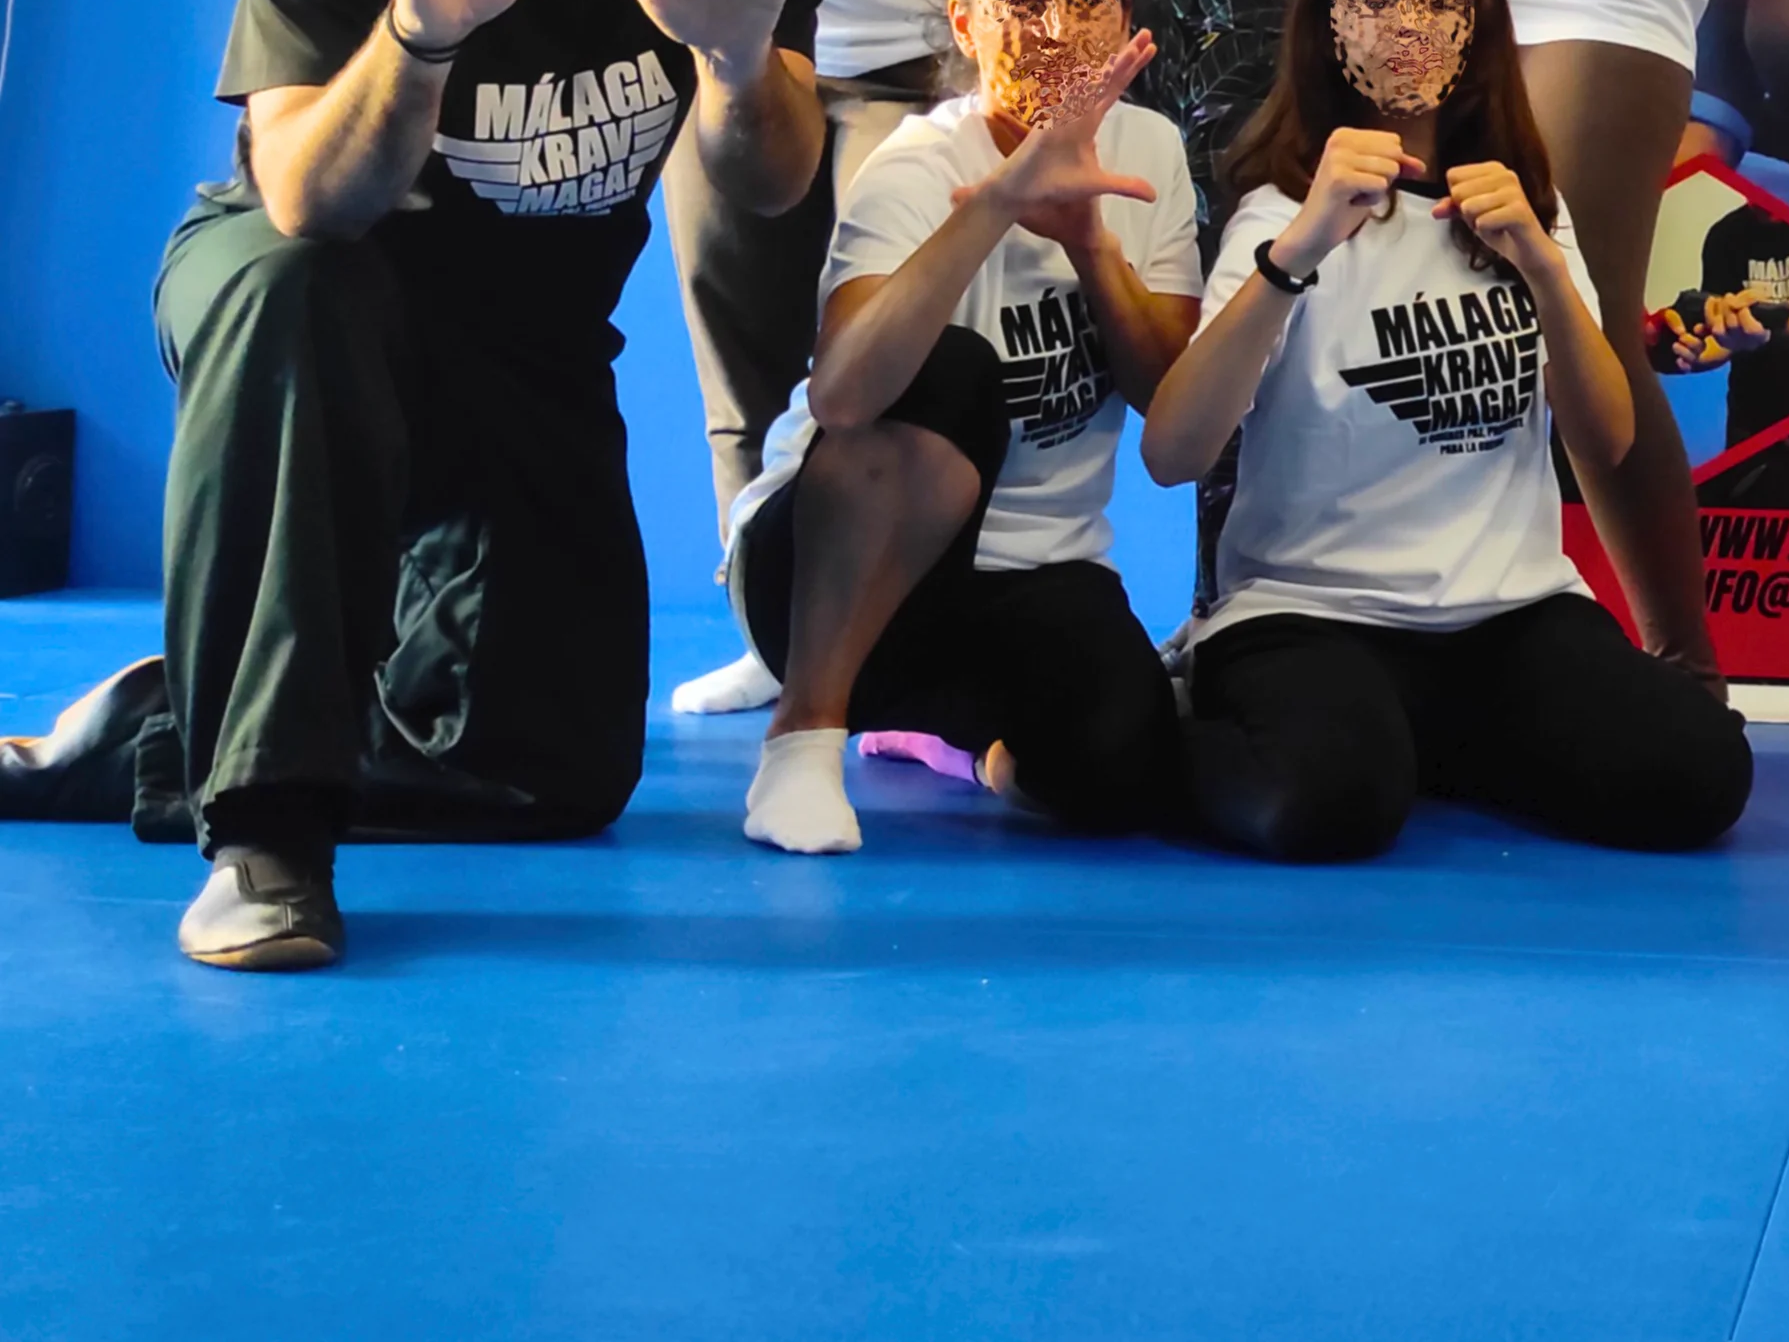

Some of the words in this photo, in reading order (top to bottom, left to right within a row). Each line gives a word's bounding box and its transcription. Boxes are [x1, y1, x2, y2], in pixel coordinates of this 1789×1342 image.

[474, 49, 677, 141] MÁLAGA
[519, 116, 634, 187] KRAV
[515, 161, 626, 214] MAGA
[1370, 285, 1539, 359] MÁLAGA
[1423, 337, 1517, 397] KRAV
[1430, 384, 1518, 433] MAGA
